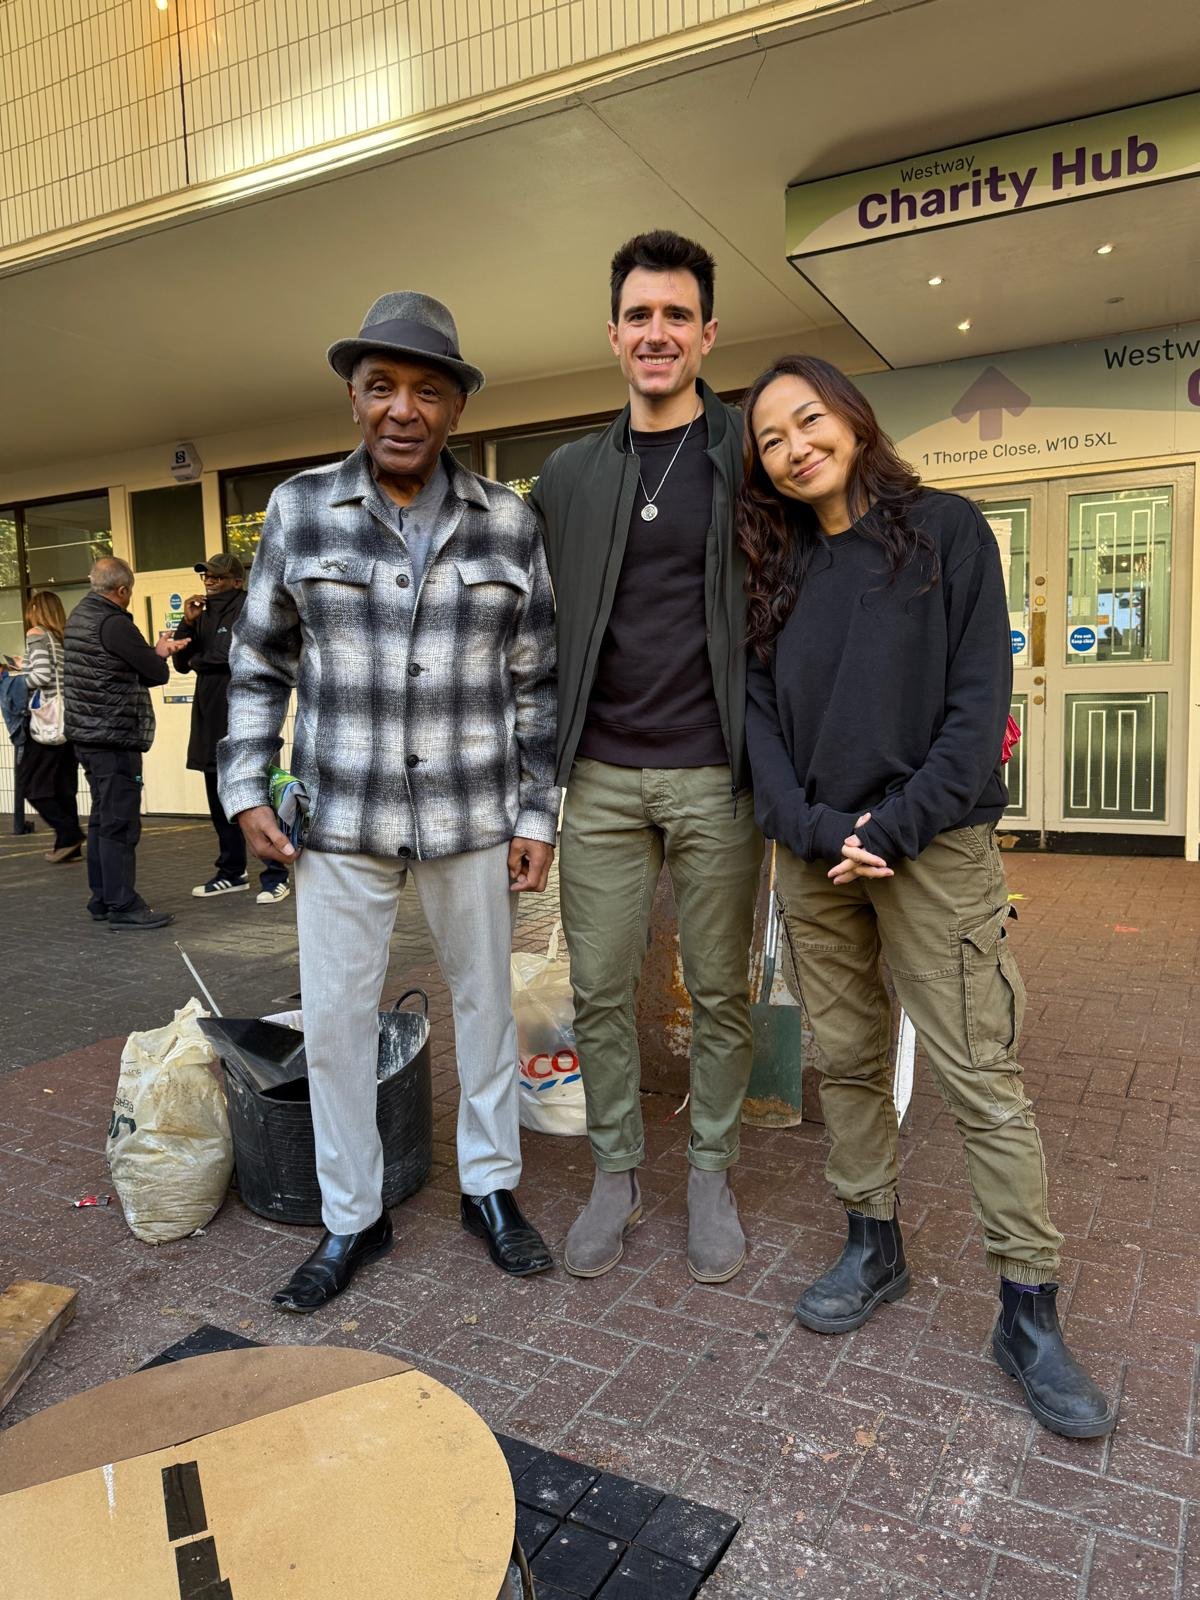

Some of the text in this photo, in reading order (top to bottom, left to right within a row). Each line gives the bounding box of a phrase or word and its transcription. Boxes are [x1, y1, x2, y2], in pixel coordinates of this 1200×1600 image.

[858, 135, 1158, 229] Charity Hub
[901, 155, 975, 183] Westway
[922, 453, 929, 466] 1
[933, 449, 988, 465] Thorpe
[1046, 435, 1079, 452] W10
[1084, 432, 1117, 448] 5XL
